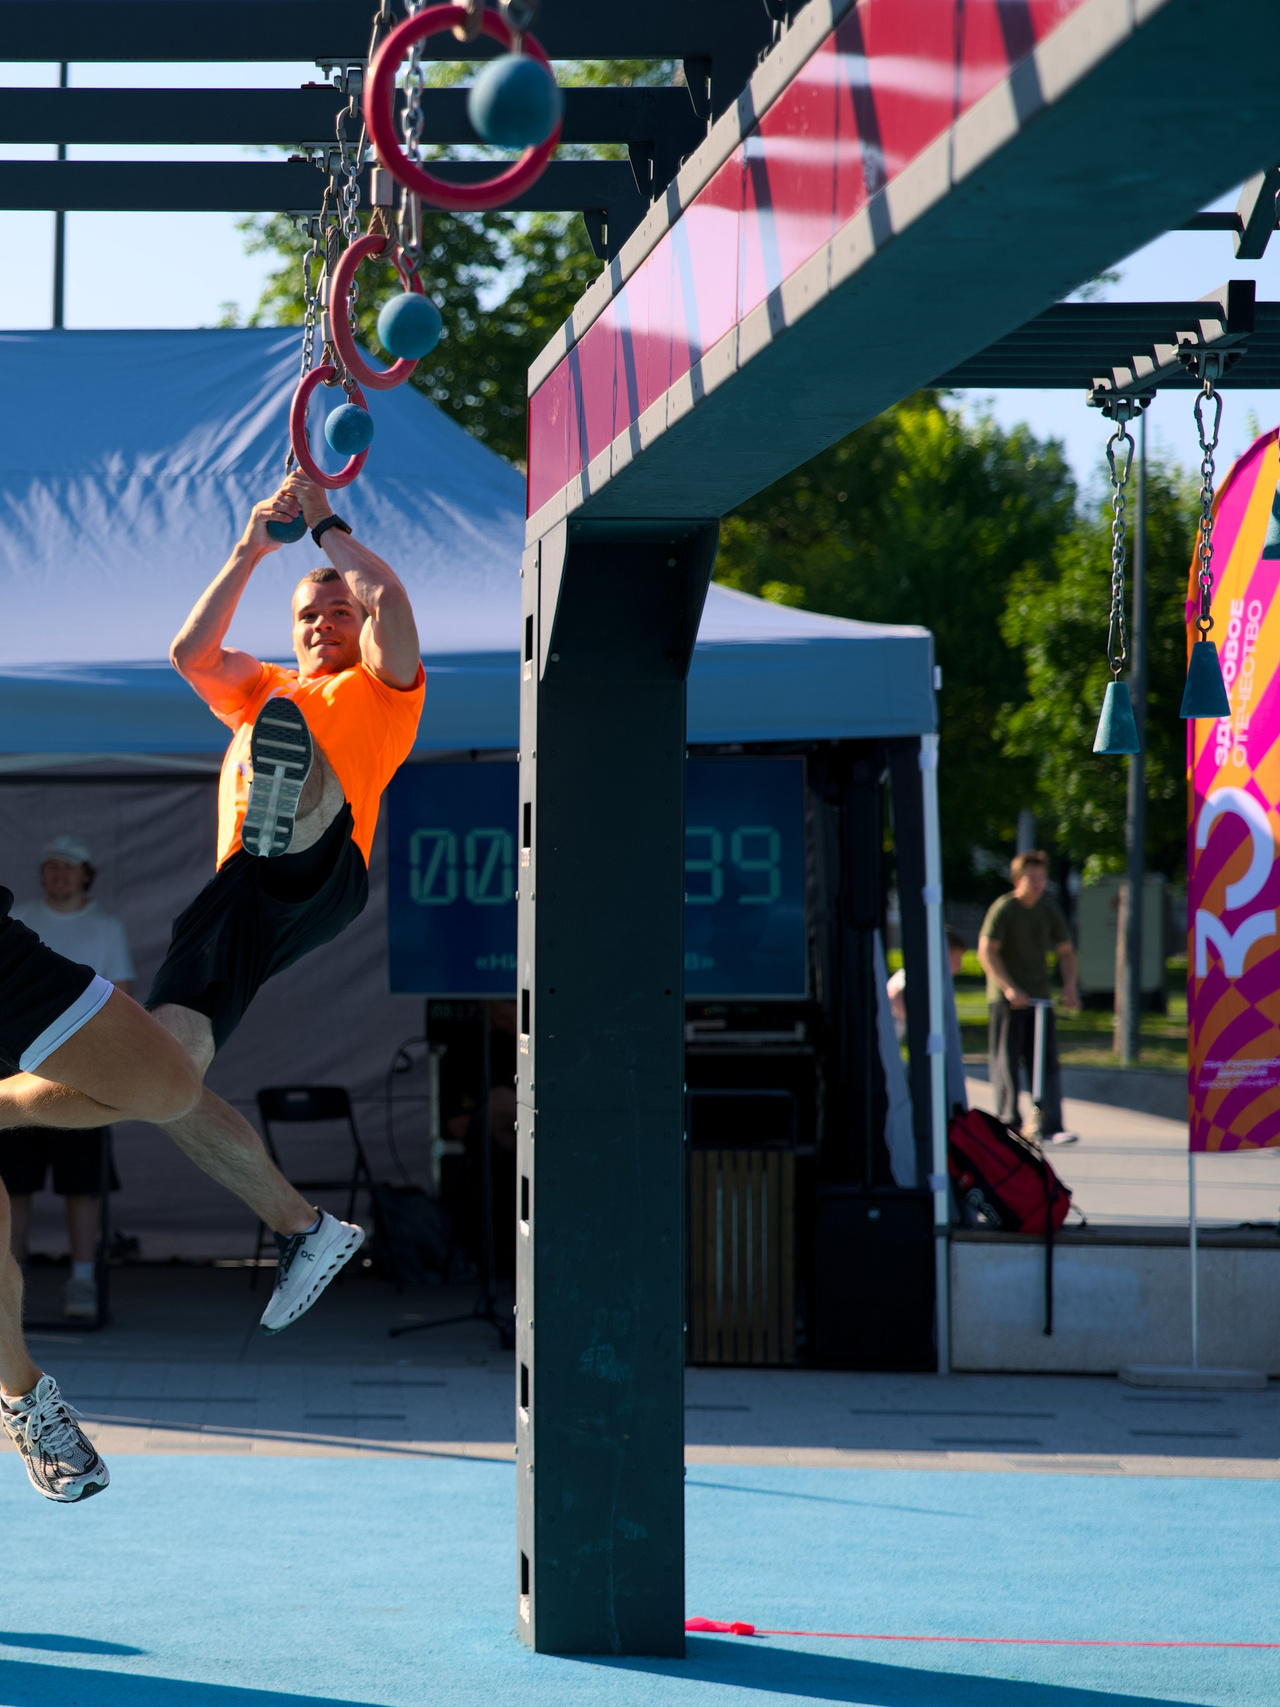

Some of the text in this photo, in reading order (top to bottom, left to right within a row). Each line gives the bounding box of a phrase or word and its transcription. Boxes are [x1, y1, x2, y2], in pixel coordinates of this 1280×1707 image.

[1214, 597, 1245, 767] ЗДОВОЕ
[1232, 599, 1263, 769] ОТЕЧЕСТВО
[410, 828, 514, 904] 00
